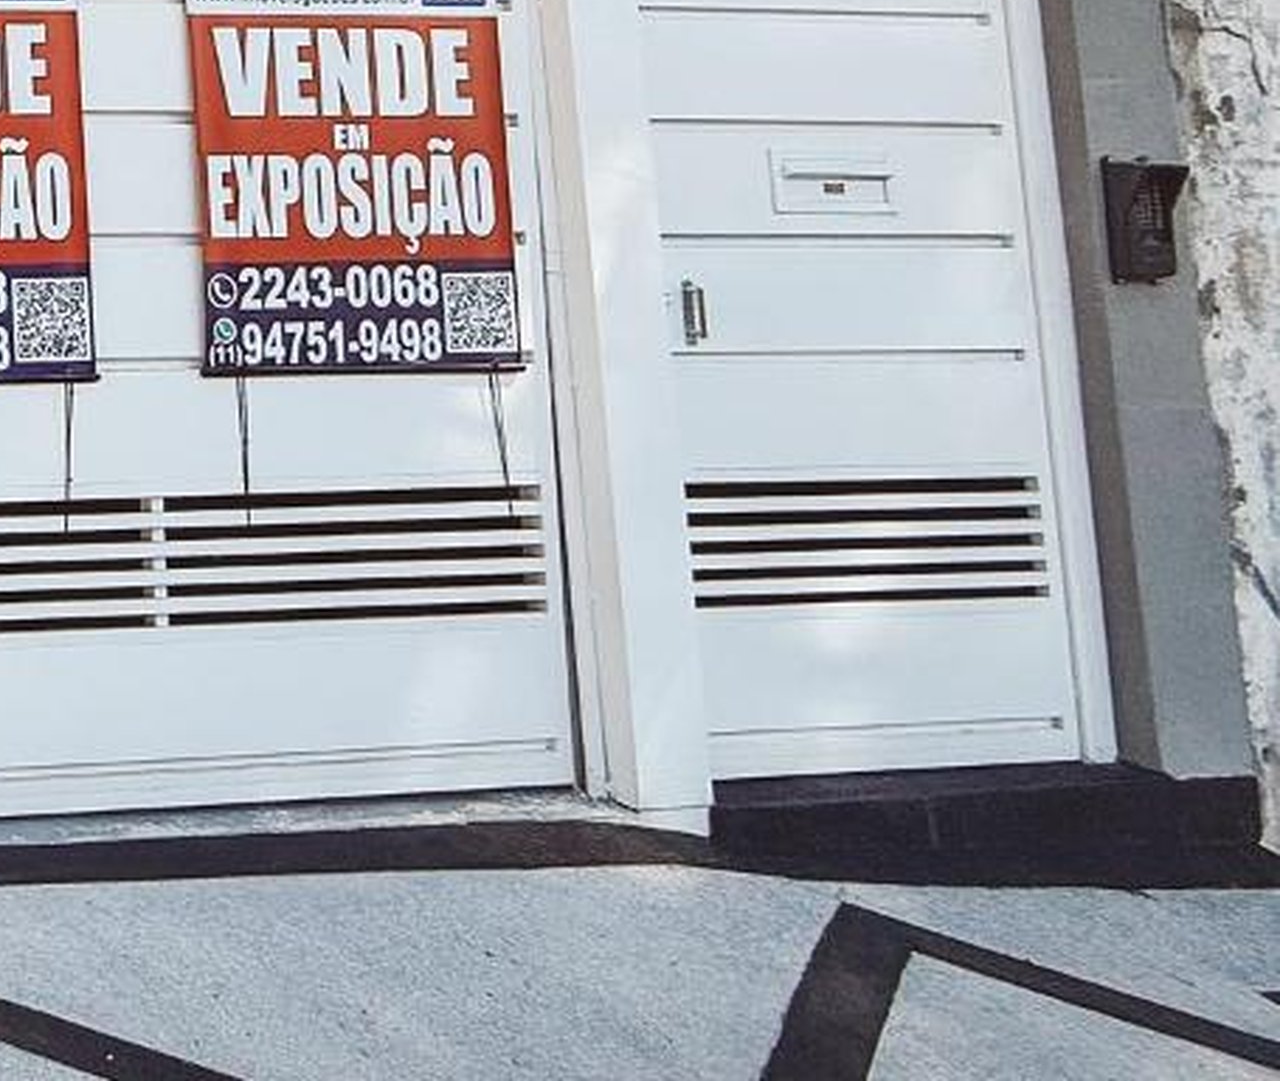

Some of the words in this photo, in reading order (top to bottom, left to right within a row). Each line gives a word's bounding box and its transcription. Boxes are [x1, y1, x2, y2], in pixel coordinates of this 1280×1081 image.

[211, 27, 475, 117] VENDE
[333, 123, 370, 150] EM
[208, 137, 497, 255] EXPOSIÇÃO
[238, 264, 439, 310] 2243-0068
[242, 318, 443, 365] 94751-9498
